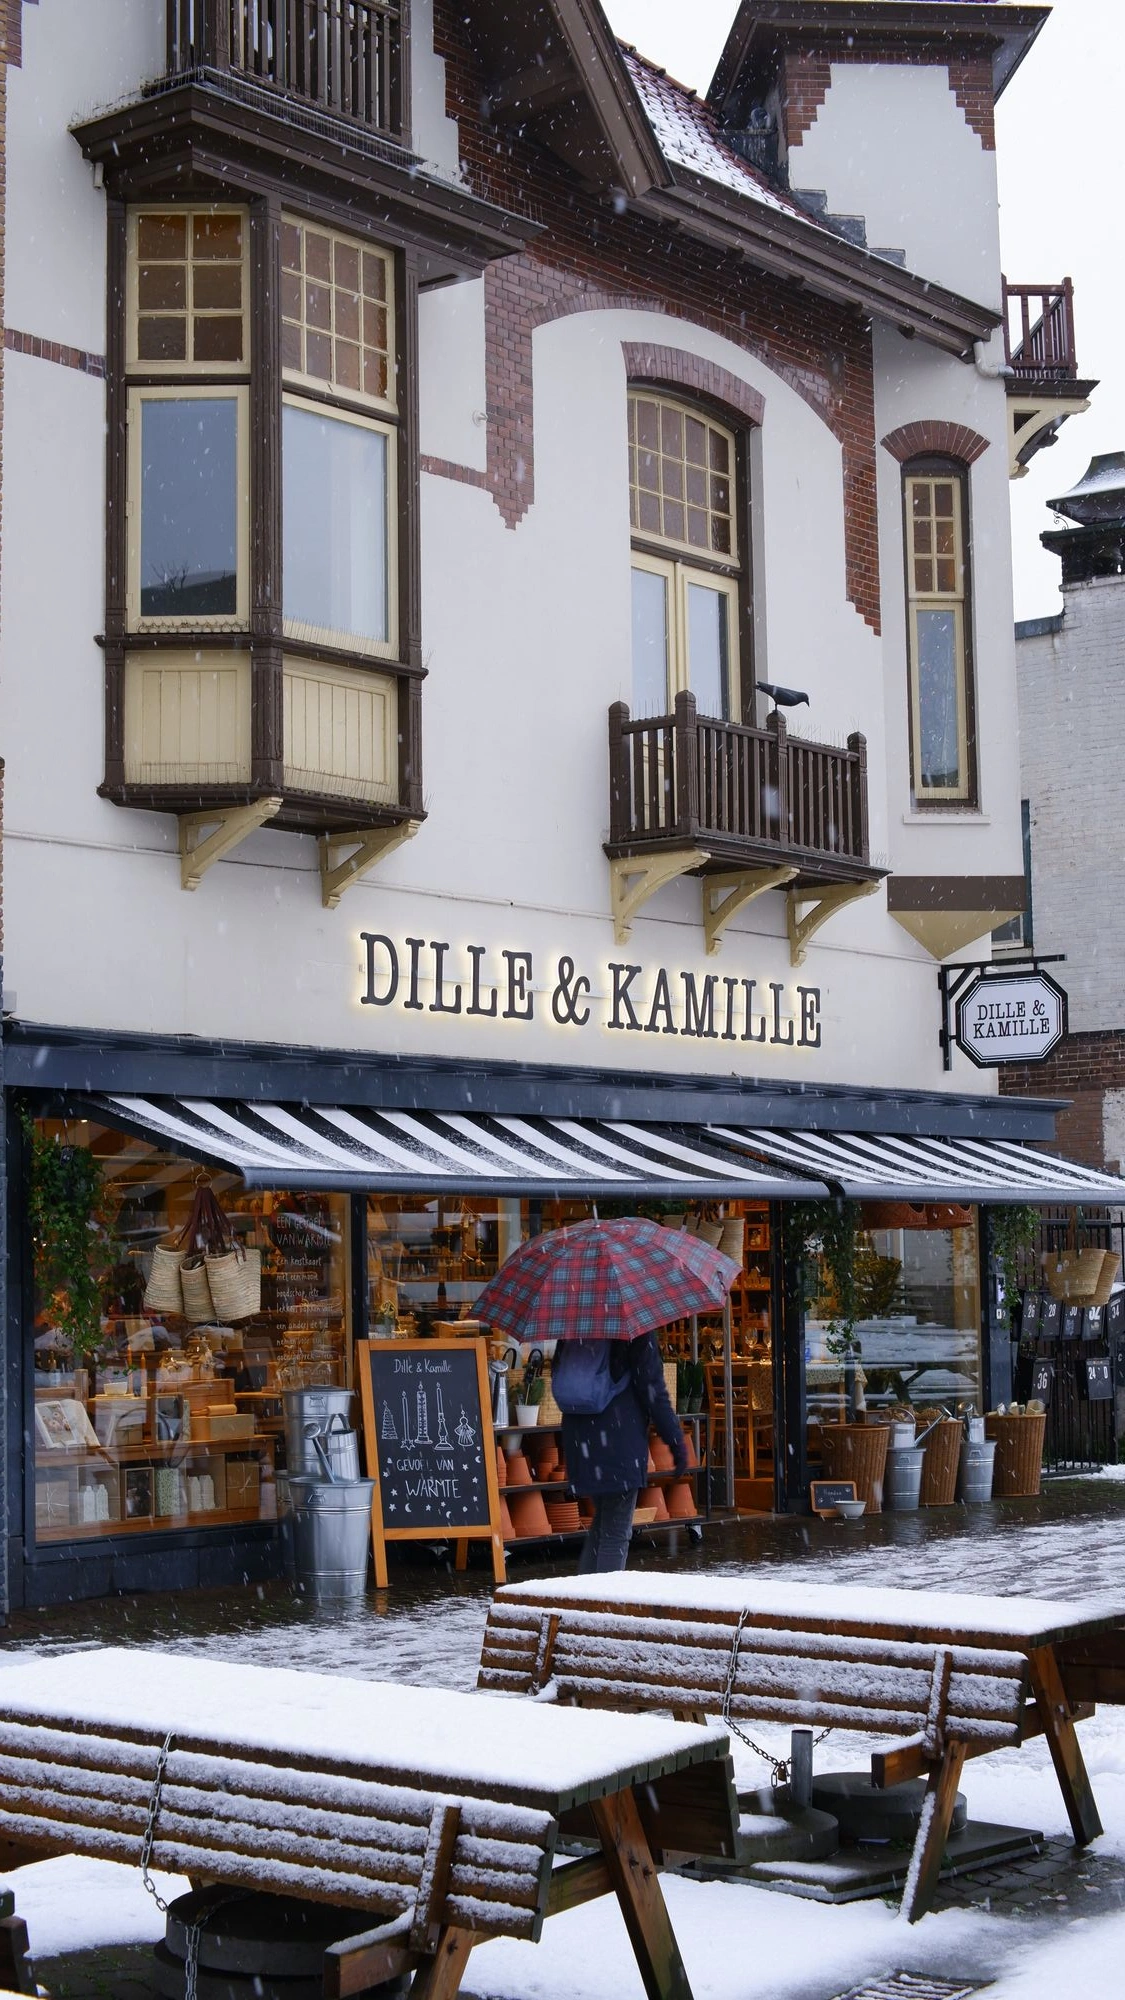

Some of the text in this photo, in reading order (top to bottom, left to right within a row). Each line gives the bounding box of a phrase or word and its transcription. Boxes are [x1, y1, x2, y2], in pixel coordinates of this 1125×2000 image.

[360, 932, 821, 1048] DILLE & KAMILLE
[977, 1000, 1045, 1020] DILLE &
[973, 1018, 1050, 1039] KAMILLE
[276, 1216, 291, 1229] EEN
[276, 1233, 295, 1245] VAN
[1027, 1304, 1035, 1318] 26
[1048, 1304, 1056, 1317] 28
[1088, 1306, 1101, 1320] 32
[1112, 1305, 1120, 1318] 34
[393, 1357, 452, 1374] Dille & Kamille
[1088, 1366, 1096, 1380] 24
[1037, 1372, 1048, 1390] 36
[436, 1459, 454, 1471] VAN
[405, 1479, 462, 1499] WARMTE
